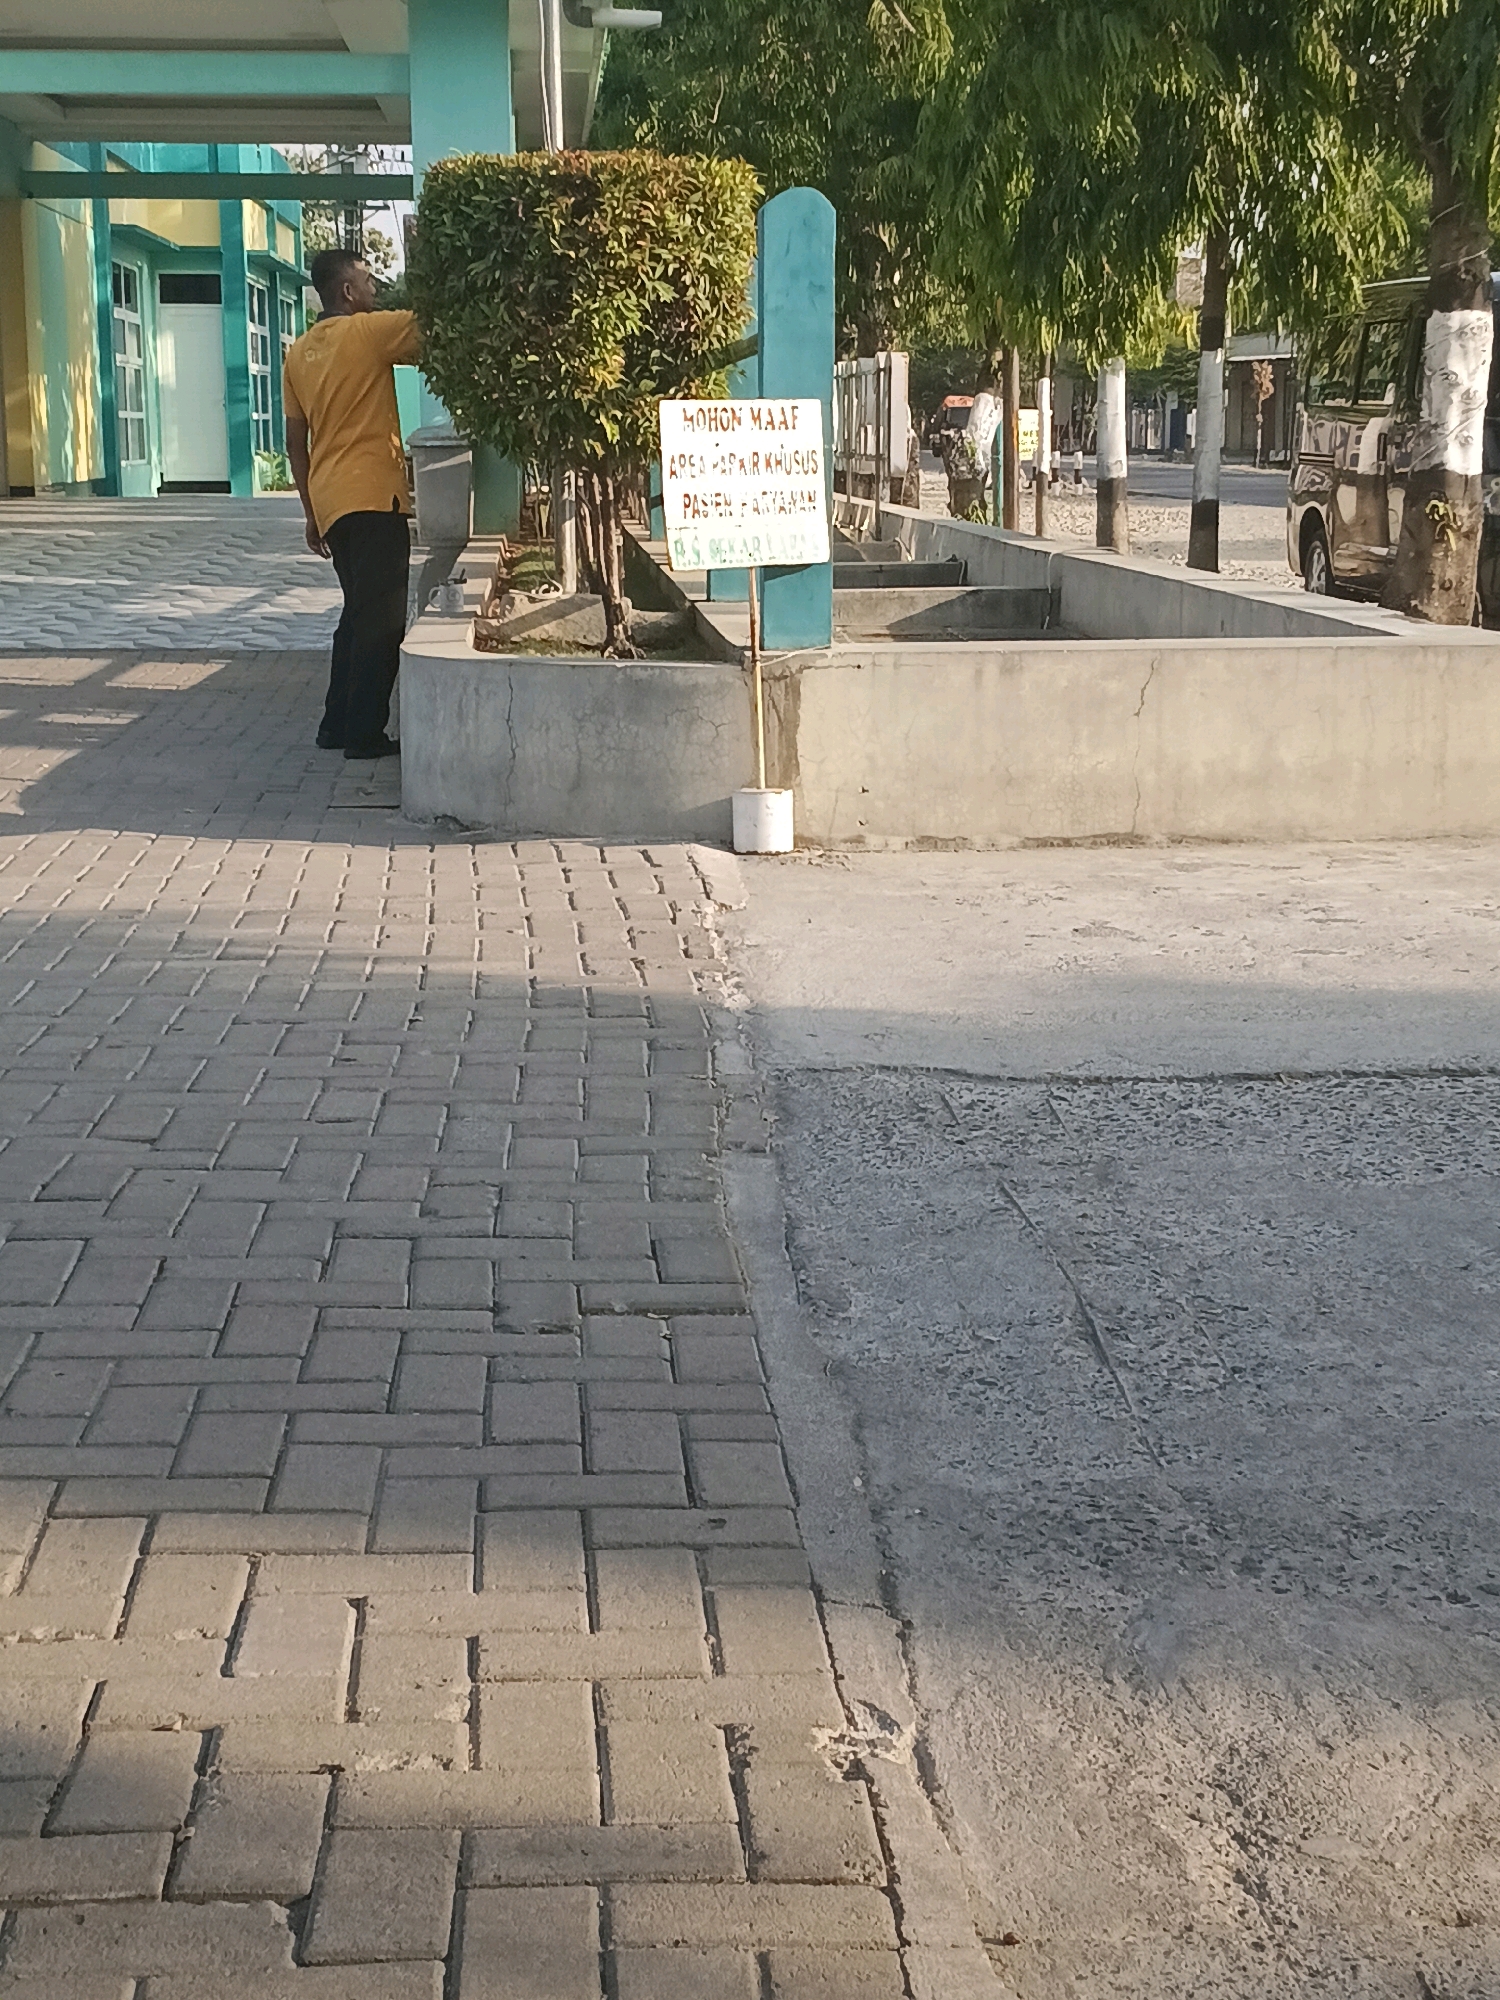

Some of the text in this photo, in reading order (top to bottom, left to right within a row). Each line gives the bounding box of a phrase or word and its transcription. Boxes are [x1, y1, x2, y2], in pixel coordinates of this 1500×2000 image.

[682, 405, 800, 432] MOHON MAAF
[669, 453, 706, 480] AREA
[764, 449, 819, 476] KHUSUS
[682, 492, 733, 519] PASIEN
